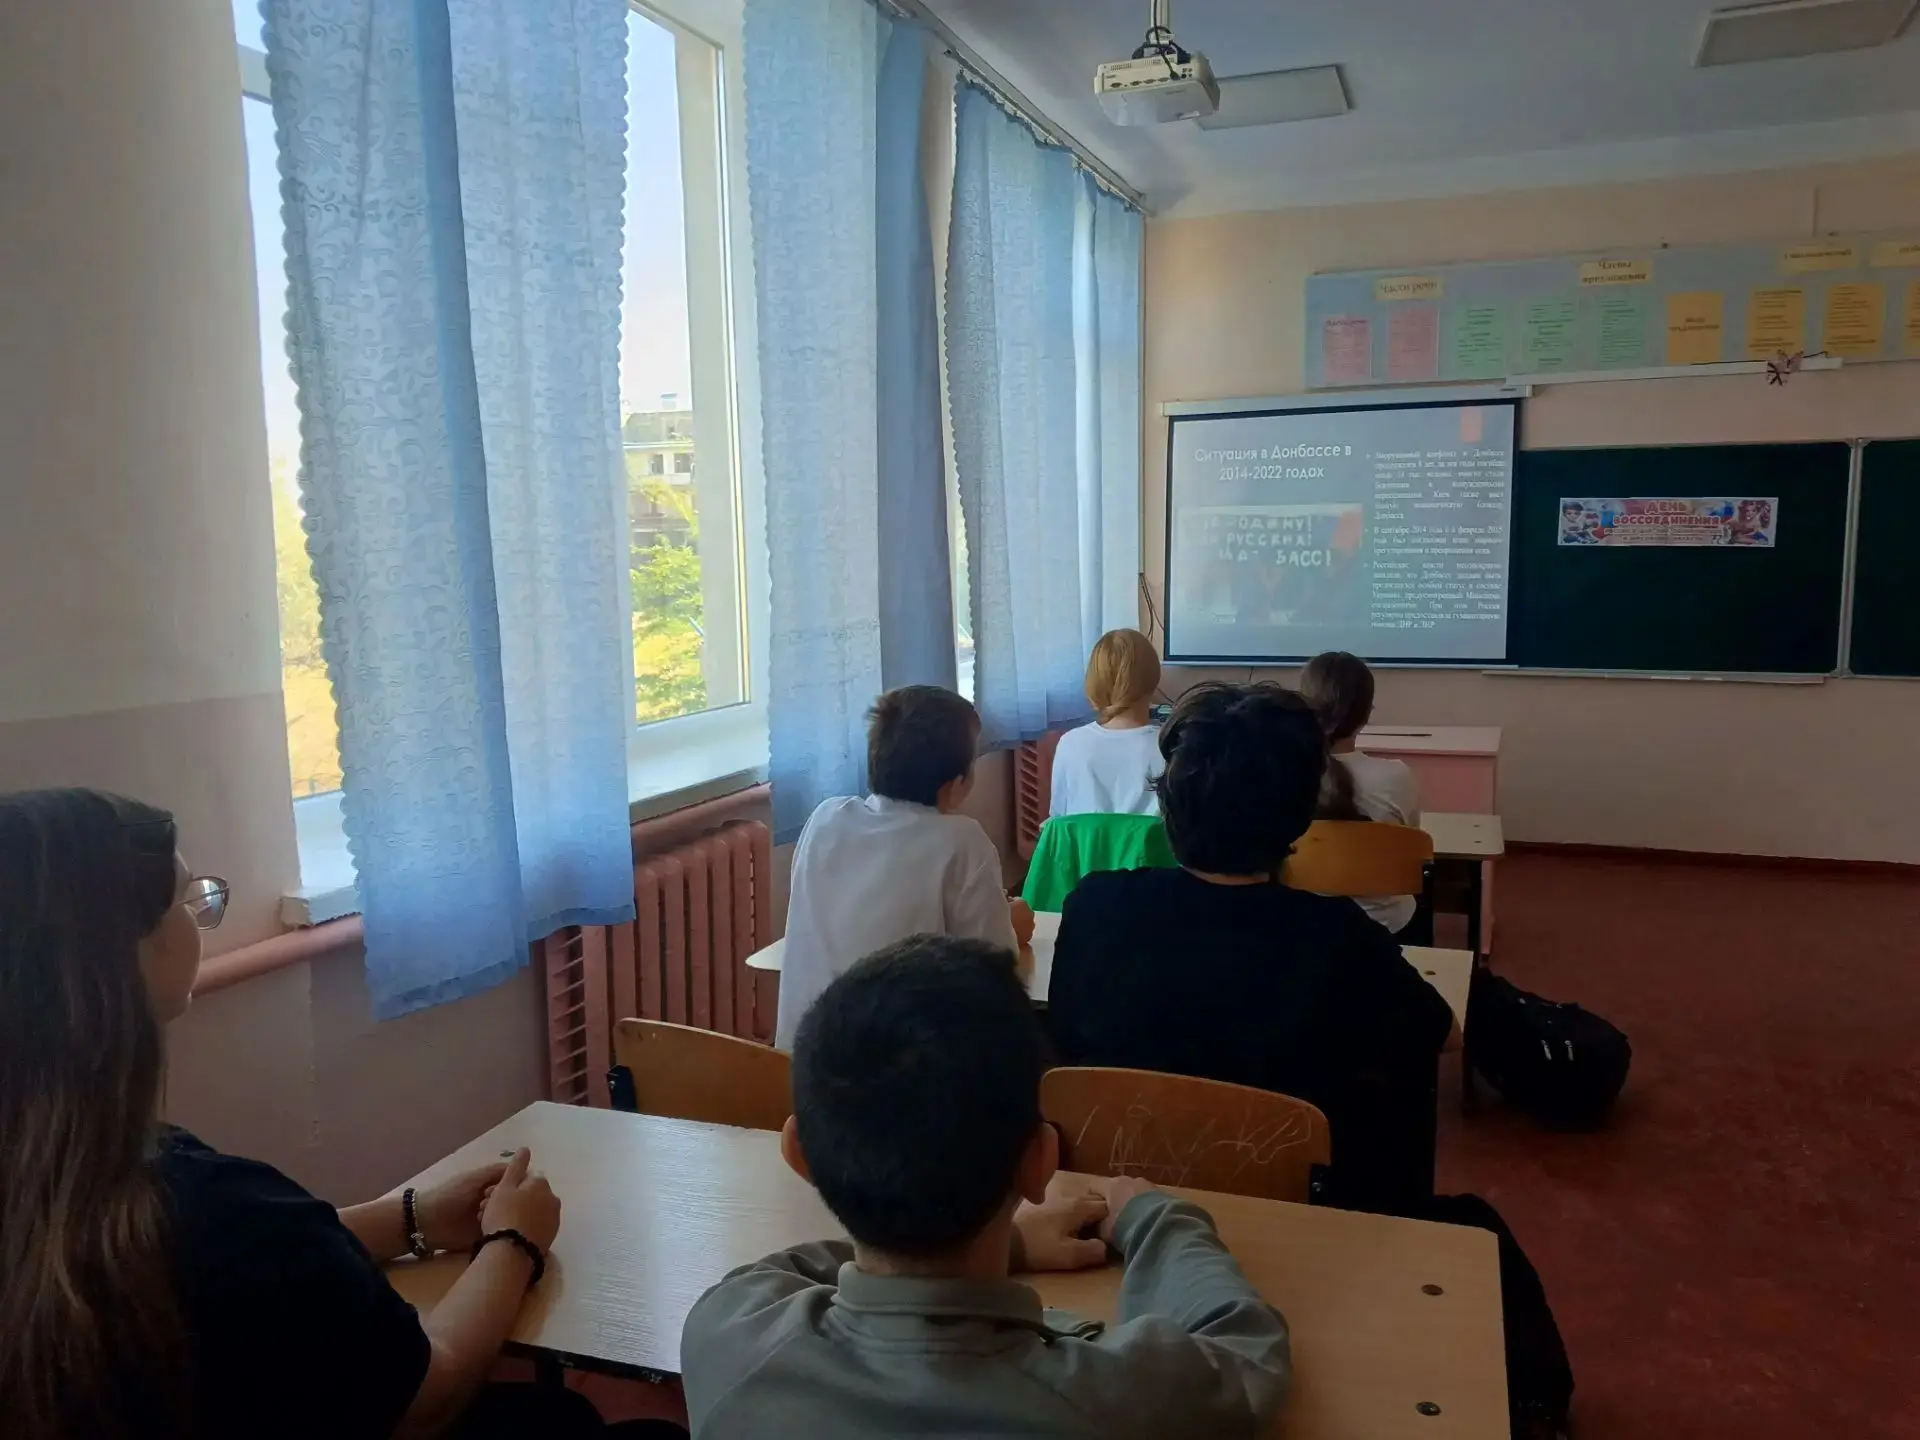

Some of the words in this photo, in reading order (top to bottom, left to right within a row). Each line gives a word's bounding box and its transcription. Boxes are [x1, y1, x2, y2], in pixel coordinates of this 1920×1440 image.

[1194, 448, 1257, 464] Ситуация
[1260, 449, 1268, 459] в
[1271, 444, 1341, 459] Донбассе
[1345, 446, 1352, 456] в
[1219, 466, 1282, 481] 2014-2022
[1285, 467, 1324, 480] годах
[1645, 502, 1687, 514] ДЕНЬ
[1613, 515, 1720, 527] ВОССОЕДИНЕНИЯ
[1226, 532, 1312, 548] РУССКИХ!
